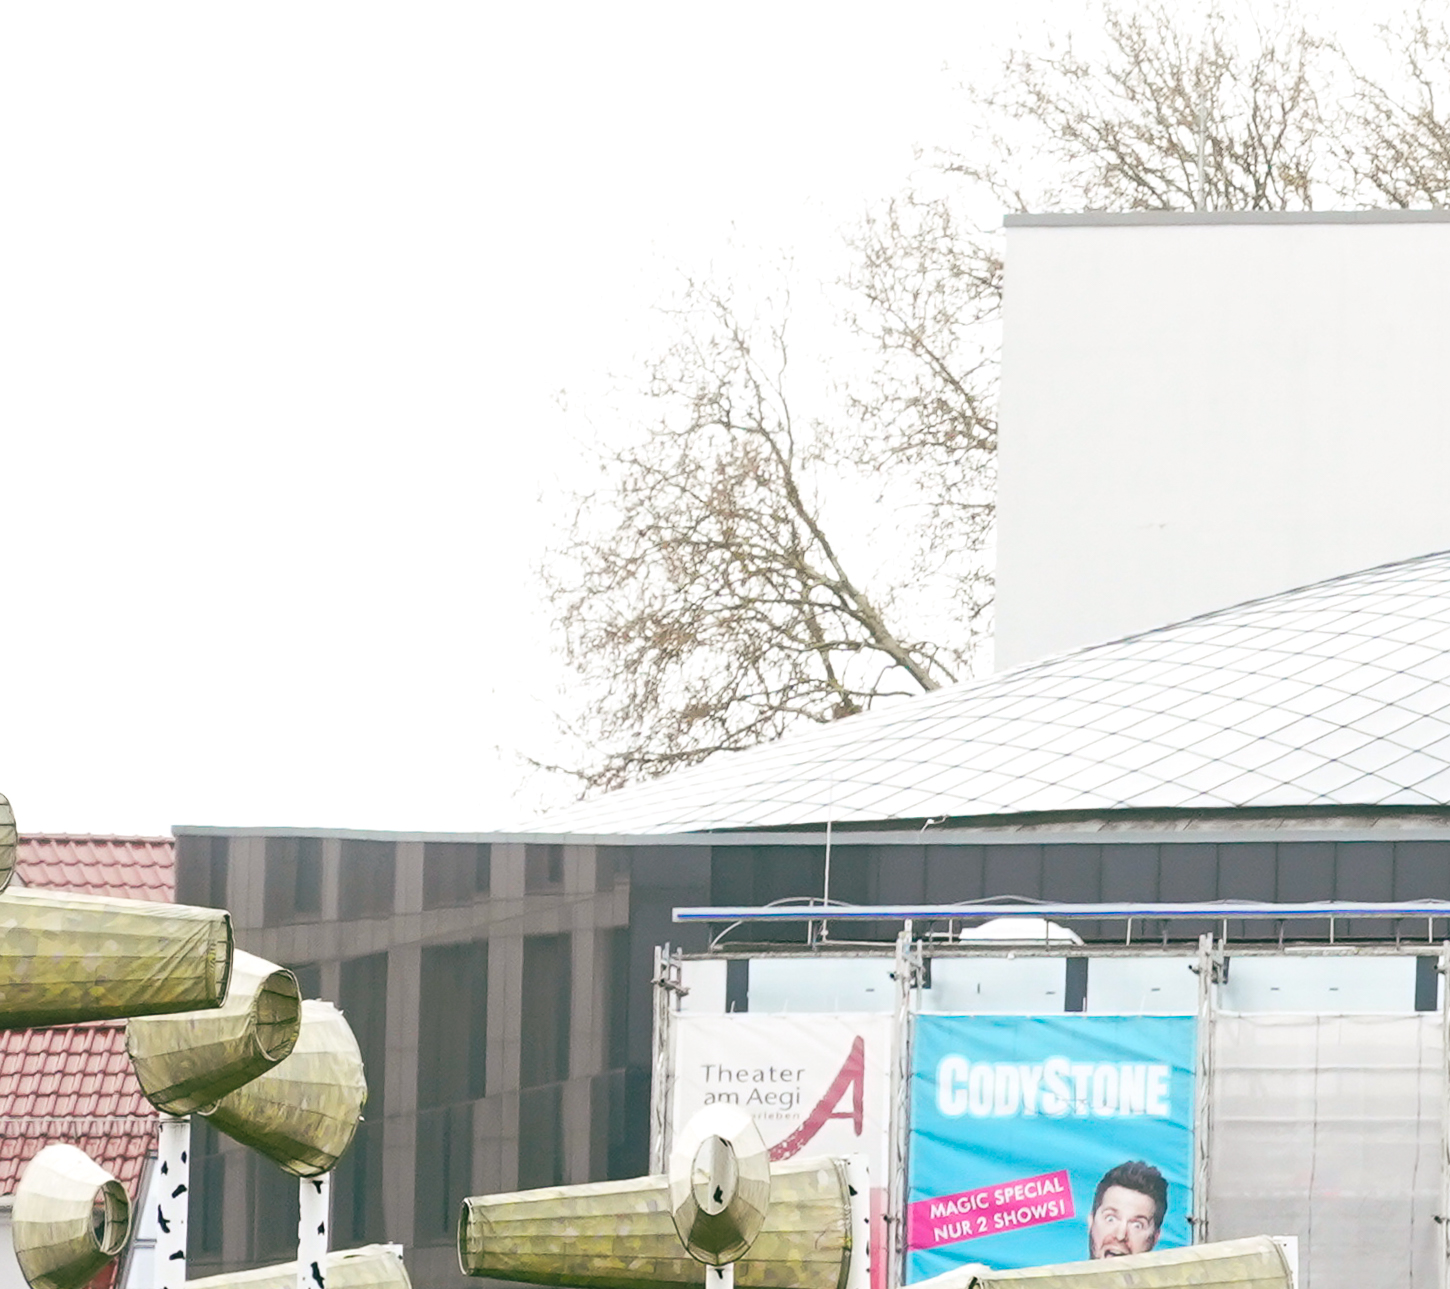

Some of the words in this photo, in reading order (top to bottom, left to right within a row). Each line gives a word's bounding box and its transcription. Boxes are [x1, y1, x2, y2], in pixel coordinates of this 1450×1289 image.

[701, 1064, 805, 1083] Theater
[704, 1092, 739, 1105] am
[746, 1087, 800, 1111] Aegi
[930, 1191, 990, 1220] MAGIC
[995, 1176, 1065, 1207] SPECIAL
[933, 1217, 973, 1240] NUR
[976, 1215, 988, 1234] 2
